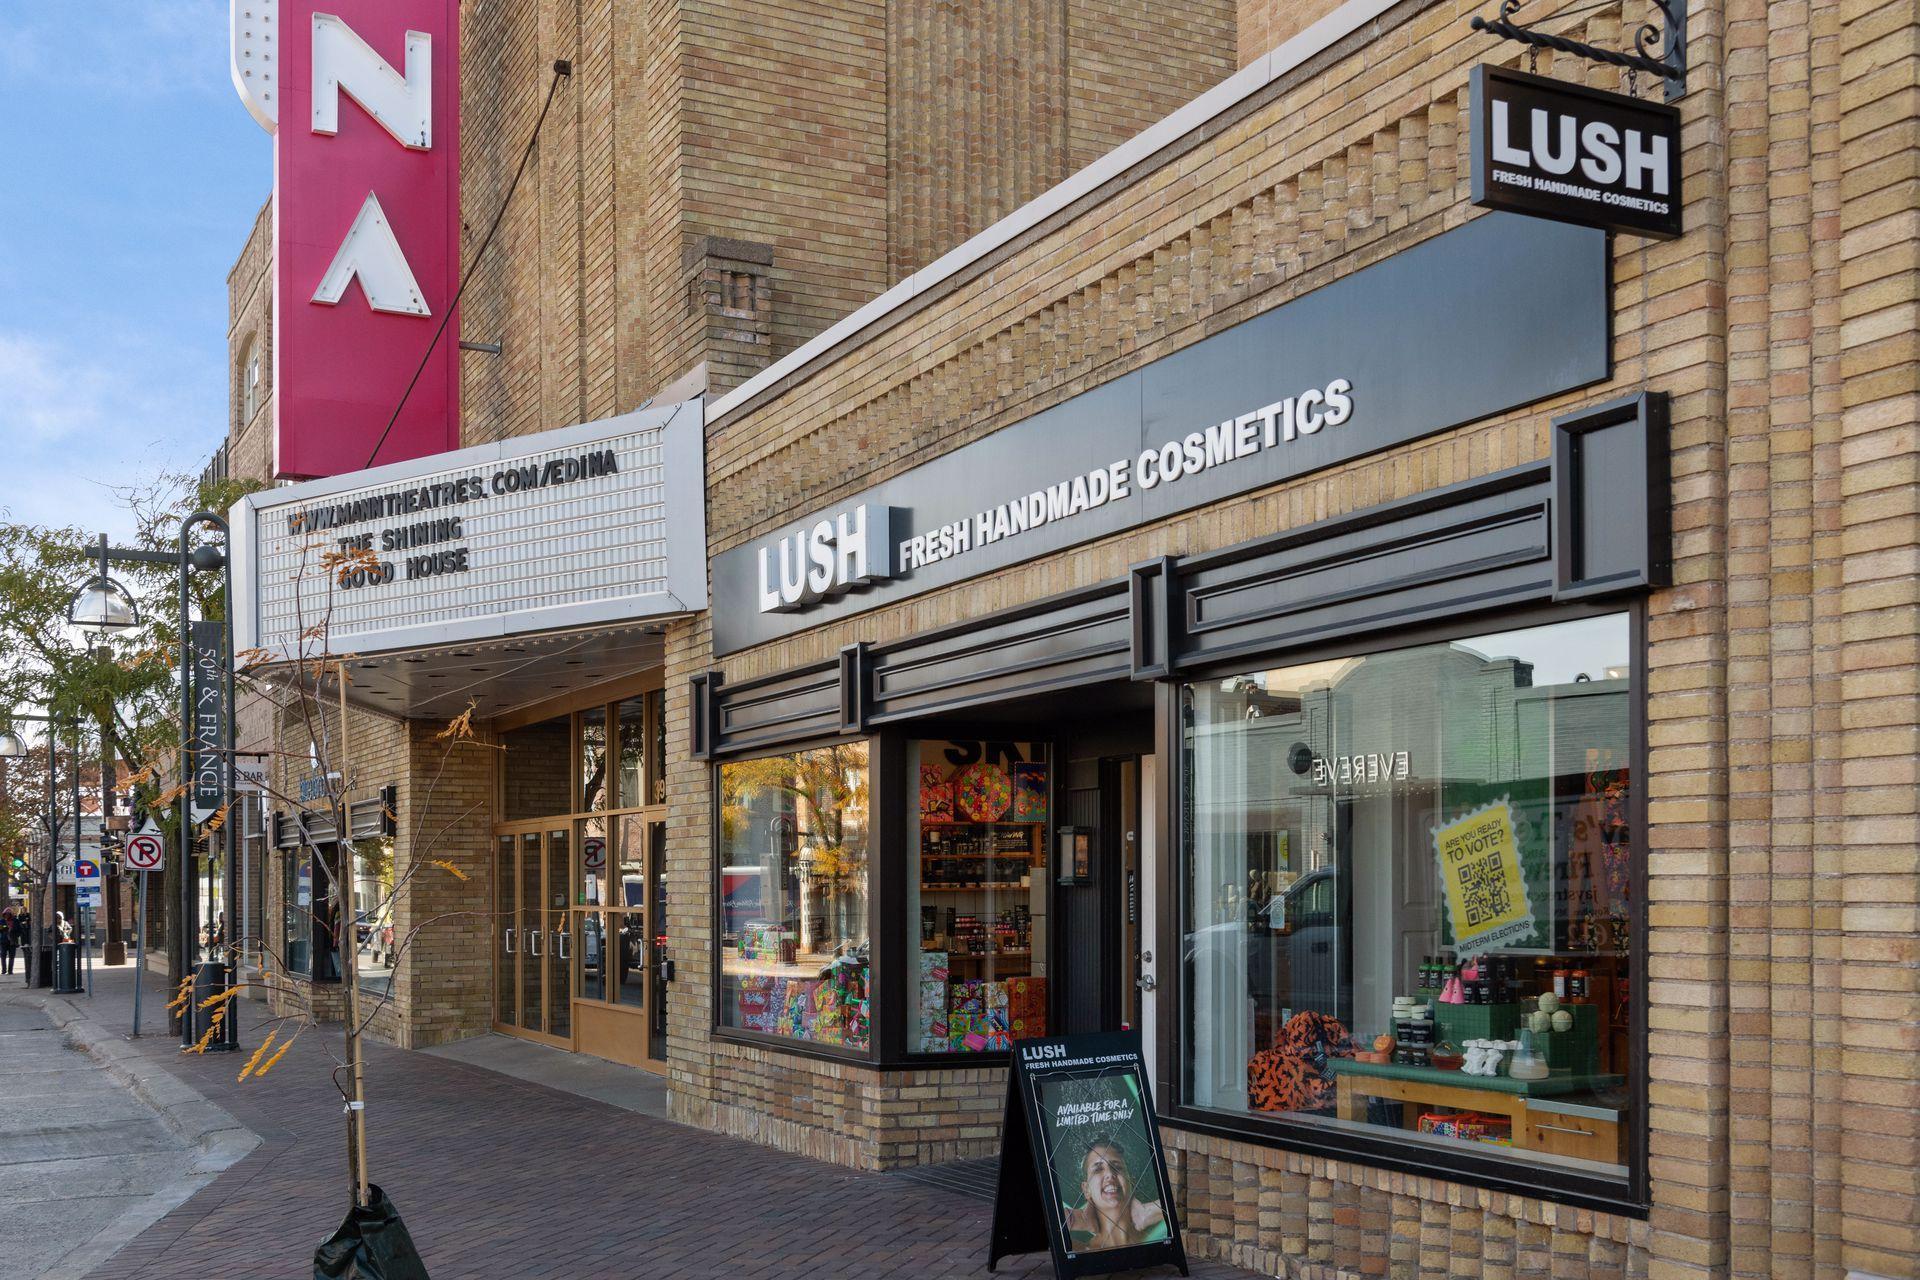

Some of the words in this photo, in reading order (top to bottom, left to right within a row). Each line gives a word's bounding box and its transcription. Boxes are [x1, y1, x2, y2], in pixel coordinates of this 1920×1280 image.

[1491, 99, 1669, 196] LUSH
[1493, 169, 1532, 188] FRESH
[1534, 178, 1601, 202] HANDMADE
[1602, 192, 1669, 215] COSMETICS
[899, 518, 972, 573] FRESH
[977, 458, 1130, 547] HANDMADE
[1137, 378, 1354, 490] COSMETICS
[338, 533, 373, 556] THE
[382, 516, 462, 552] SHINING
[406, 547, 469, 580] HOUSE
[758, 503, 874, 614] LUSH
[198, 647, 220, 681] 50th
[198, 686, 219, 709] &
[199, 713, 218, 797] FRANCE
[244, 771, 263, 781] BAR
[1445, 836, 1460, 850] ARE
[1461, 829, 1477, 843] YOU
[1477, 818, 1502, 838] READY
[1447, 847, 1465, 864] TO
[1466, 828, 1505, 856] VOTE?
[1459, 934, 1490, 953] MIDTERM
[1491, 921, 1530, 942] ELECTIONS
[1022, 1044, 1067, 1060] LUSH
[1025, 1061, 1050, 1070] FRESH
[1052, 1057, 1094, 1068] HANDMADE
[1095, 1053, 1138, 1063] COSMETICS
[1056, 1115, 1090, 1128] LIMITED
[1091, 1112, 1112, 1126] TIME
[1113, 1108, 1134, 1121] ONLY
[1057, 1101, 1101, 1116] AVAILABLE
[1103, 1099, 1121, 1111] FOR
[1121, 1098, 1128, 1108] A
